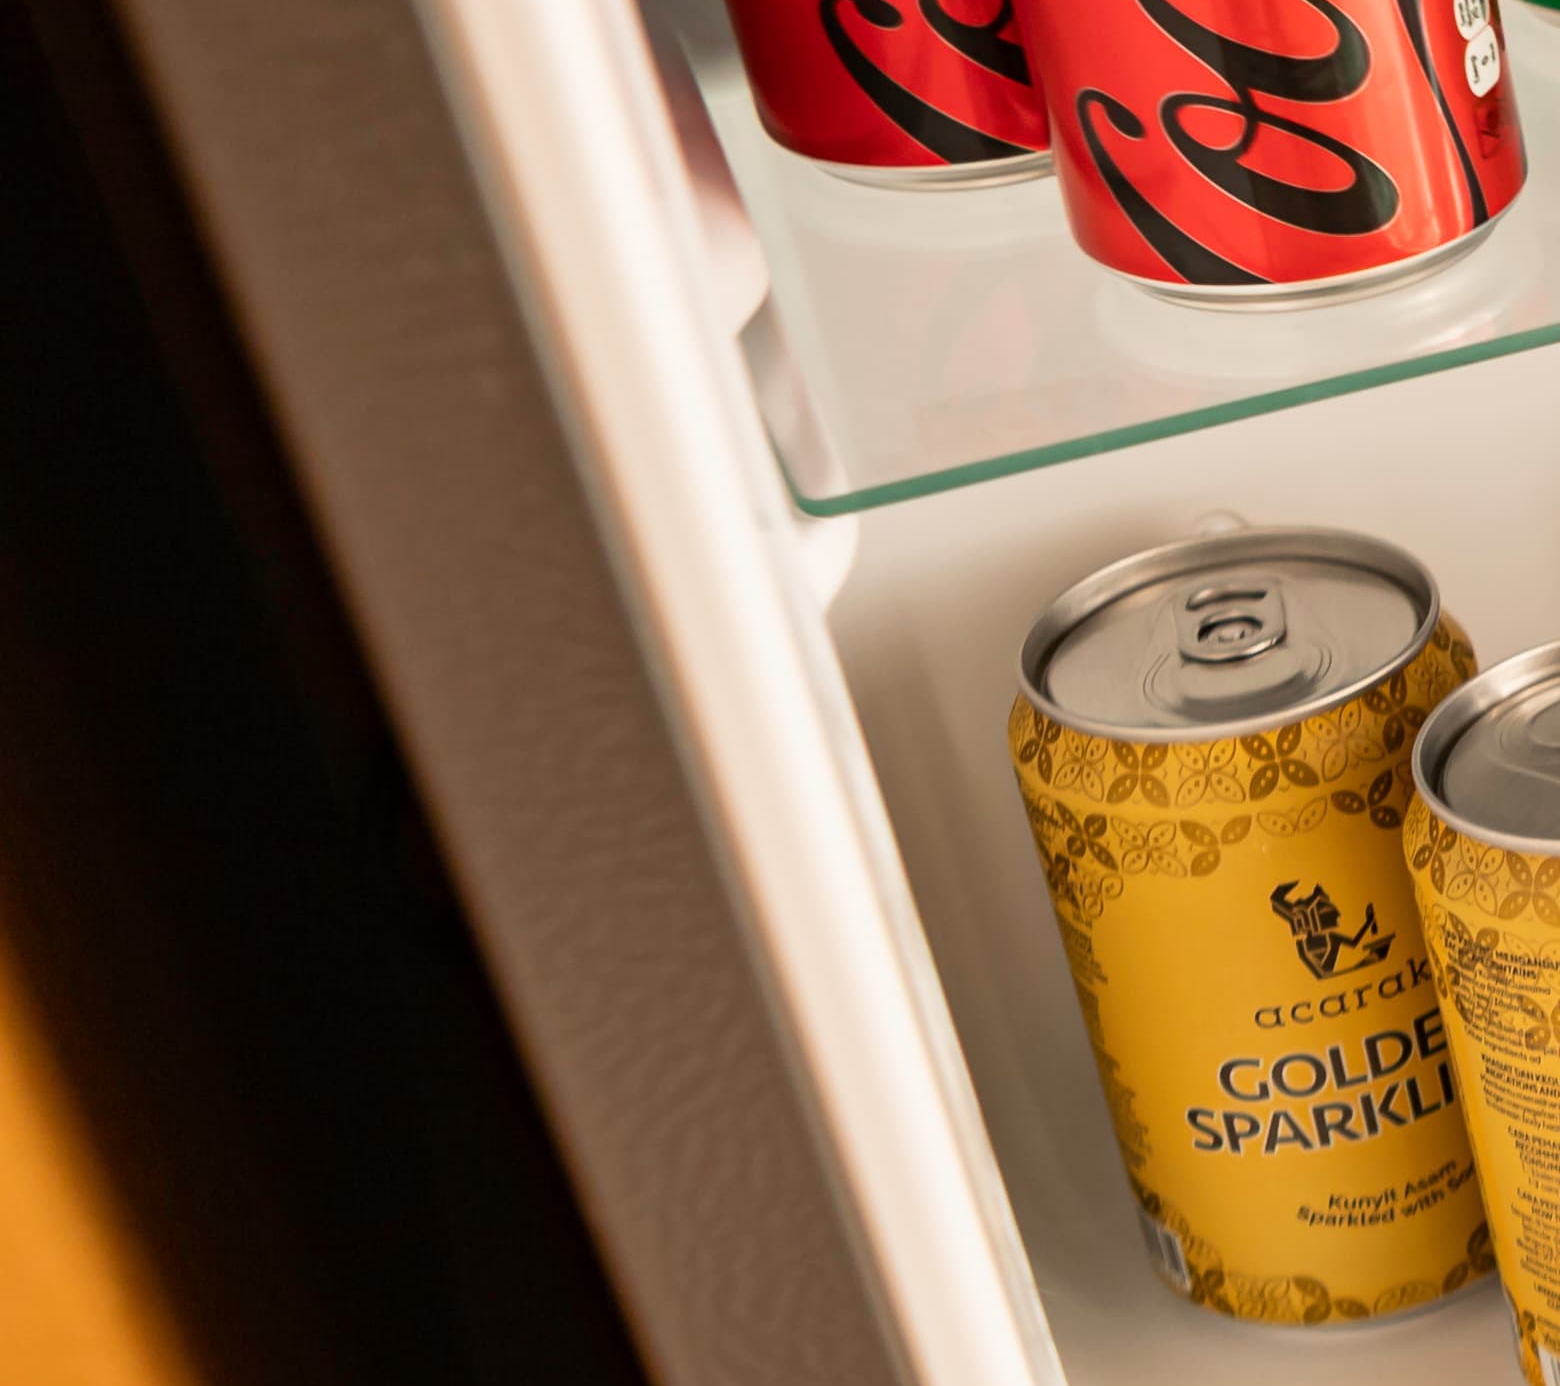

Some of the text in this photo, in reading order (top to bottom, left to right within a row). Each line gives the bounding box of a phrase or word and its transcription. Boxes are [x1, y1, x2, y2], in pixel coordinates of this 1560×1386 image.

[1539, 1086, 1560, 1098] AND
[1328, 1159, 1457, 1211] Kunyit Asam
[1296, 1204, 1396, 1227] Sparkled
[1400, 1188, 1445, 1218] with
[1532, 1207, 1552, 1221] HOW
